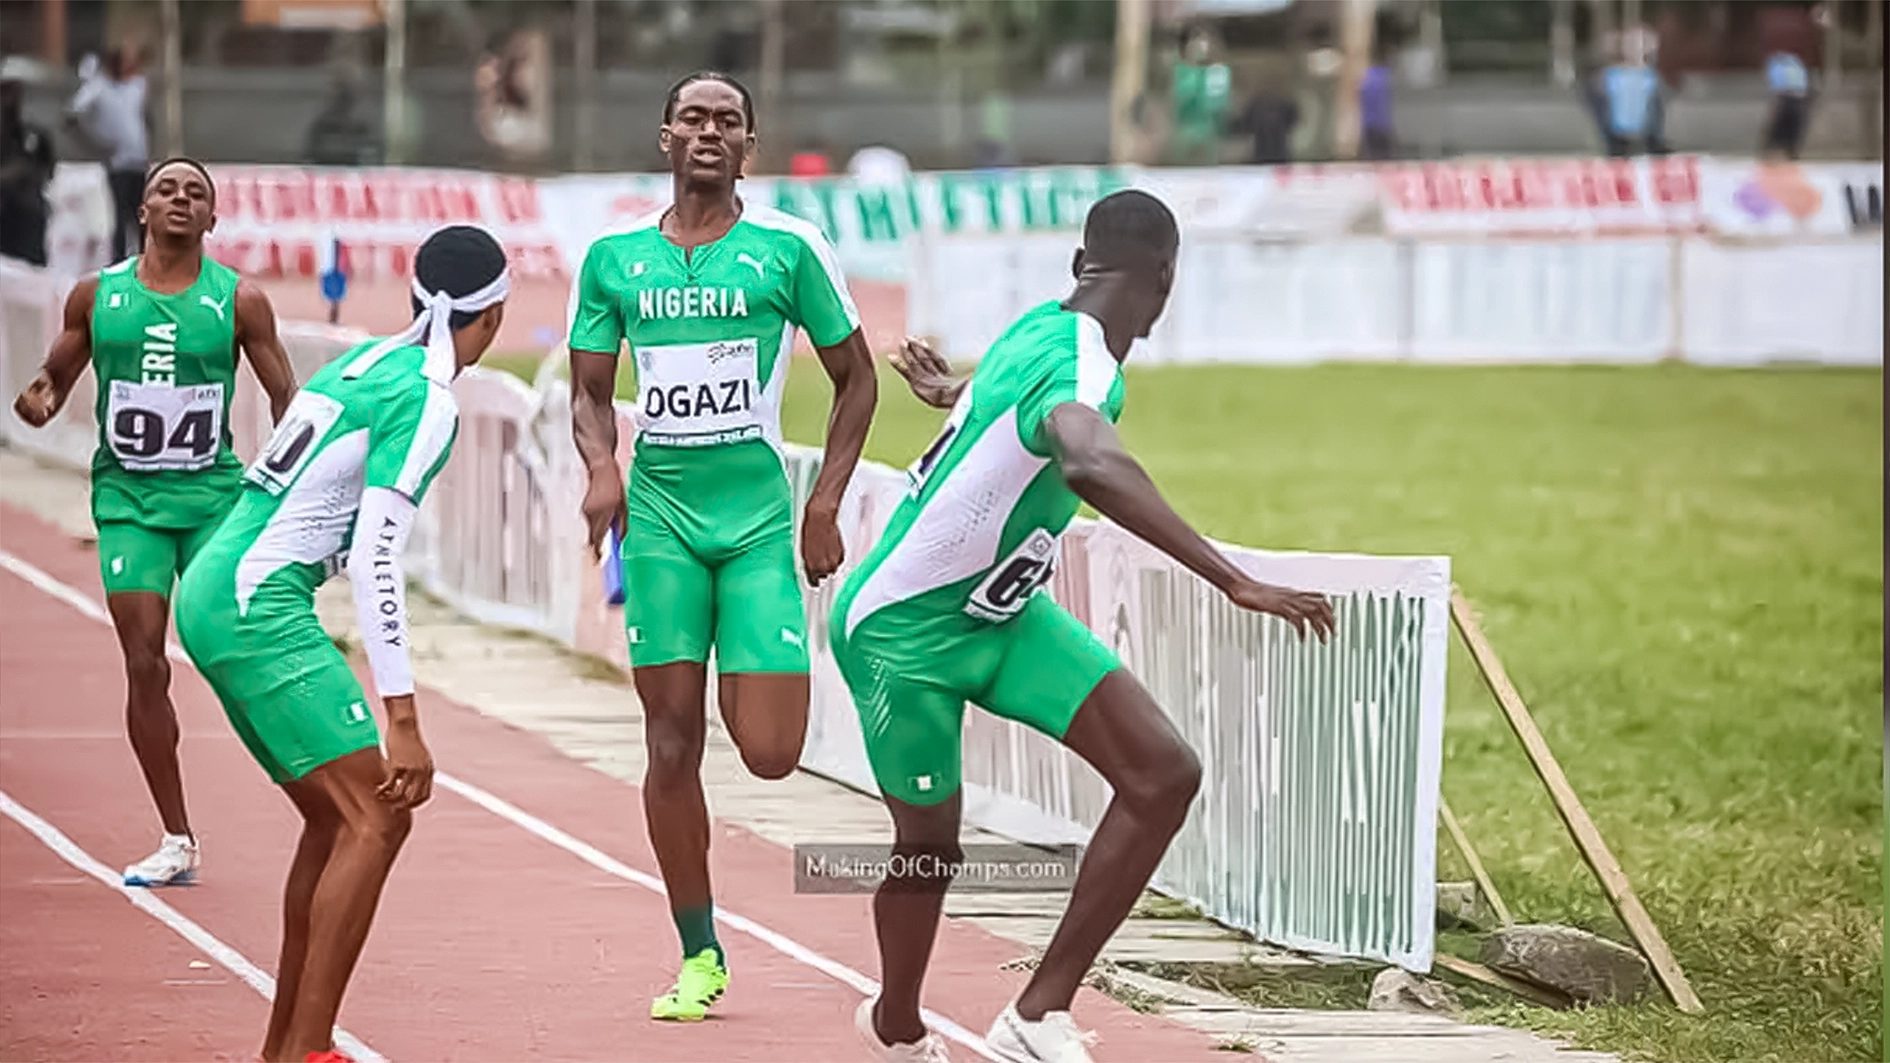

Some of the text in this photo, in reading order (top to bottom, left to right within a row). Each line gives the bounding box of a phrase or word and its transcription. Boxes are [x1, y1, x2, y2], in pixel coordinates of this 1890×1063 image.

[638, 286, 749, 319] NIGERIA
[142, 322, 178, 388] ERIA
[645, 378, 751, 419] OGAZI
[114, 408, 216, 458] 94
